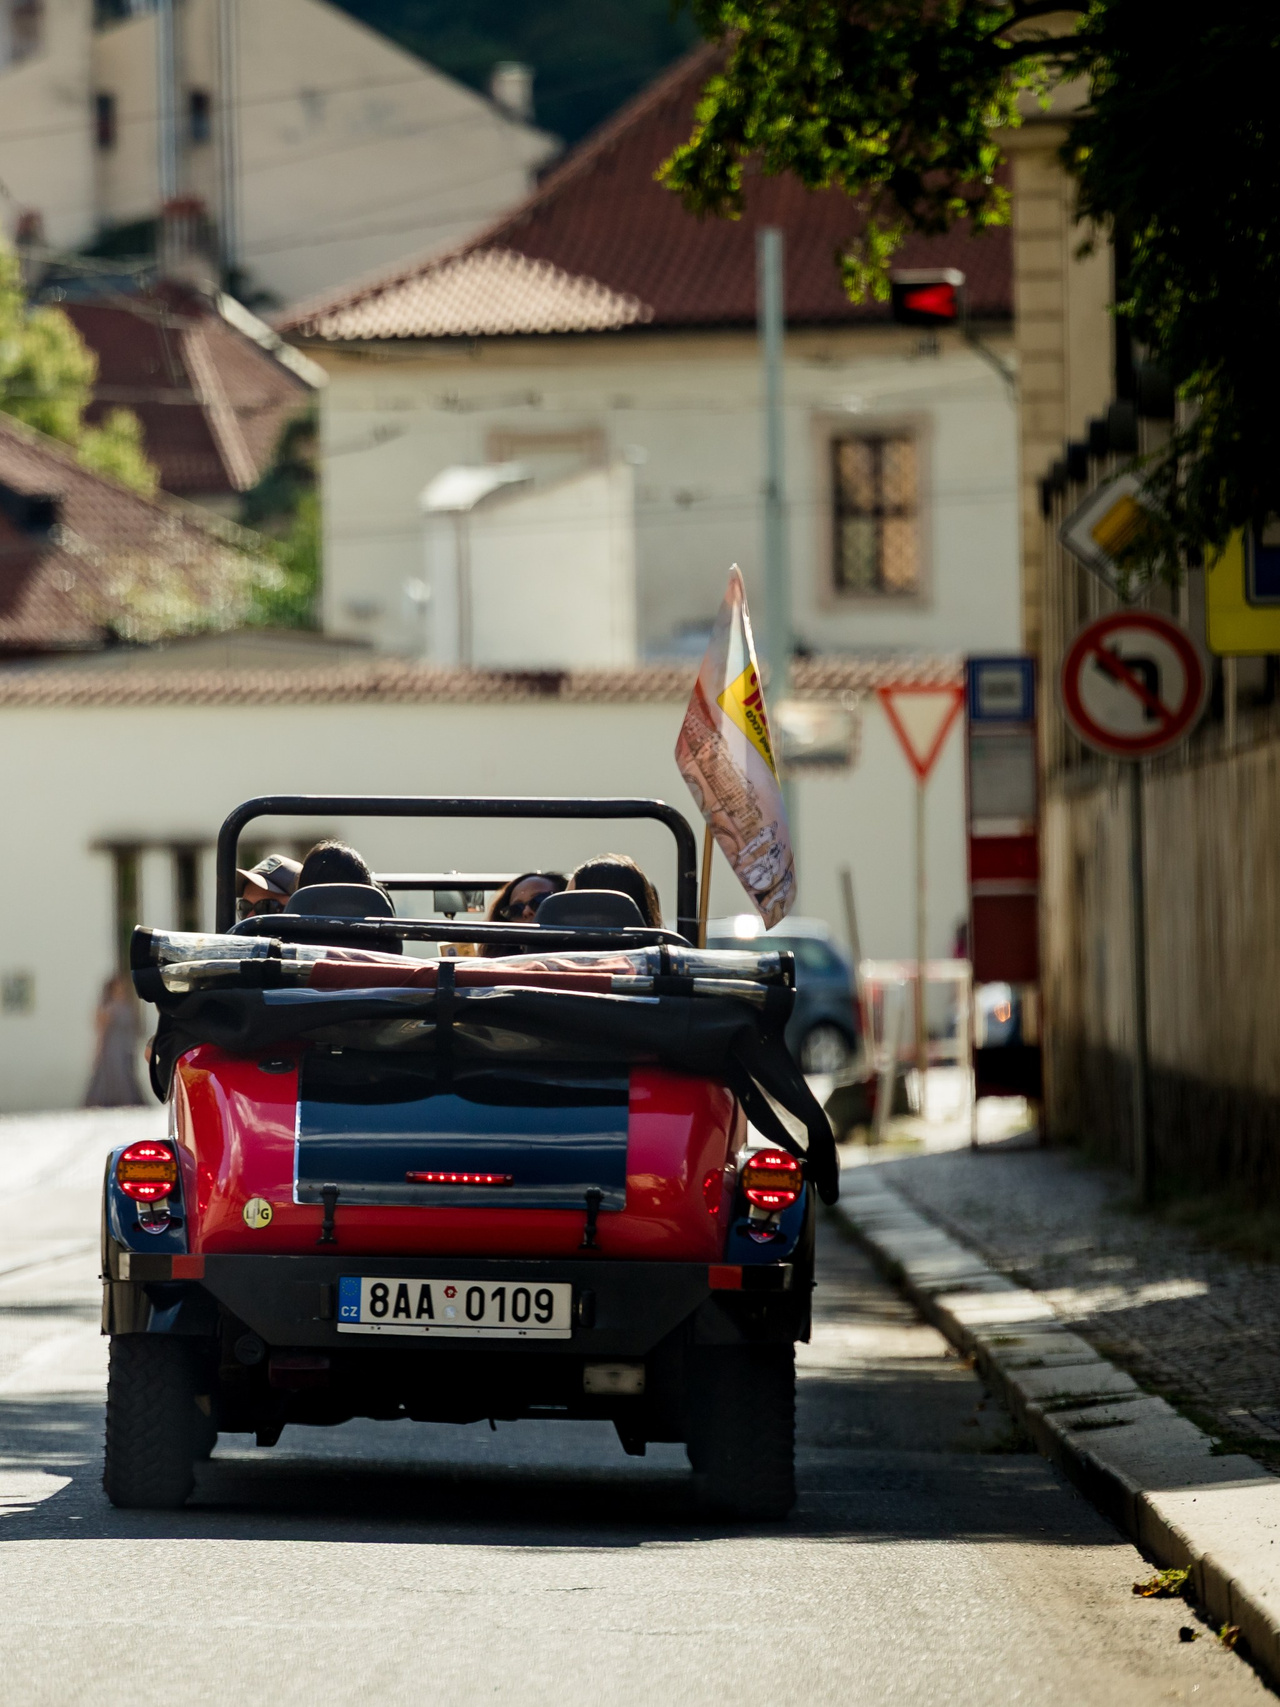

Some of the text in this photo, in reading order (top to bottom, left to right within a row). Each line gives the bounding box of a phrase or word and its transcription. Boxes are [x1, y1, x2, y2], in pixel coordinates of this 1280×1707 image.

[341, 1305, 358, 1318] CZ
[369, 1282, 554, 1324] 8AA 0109
